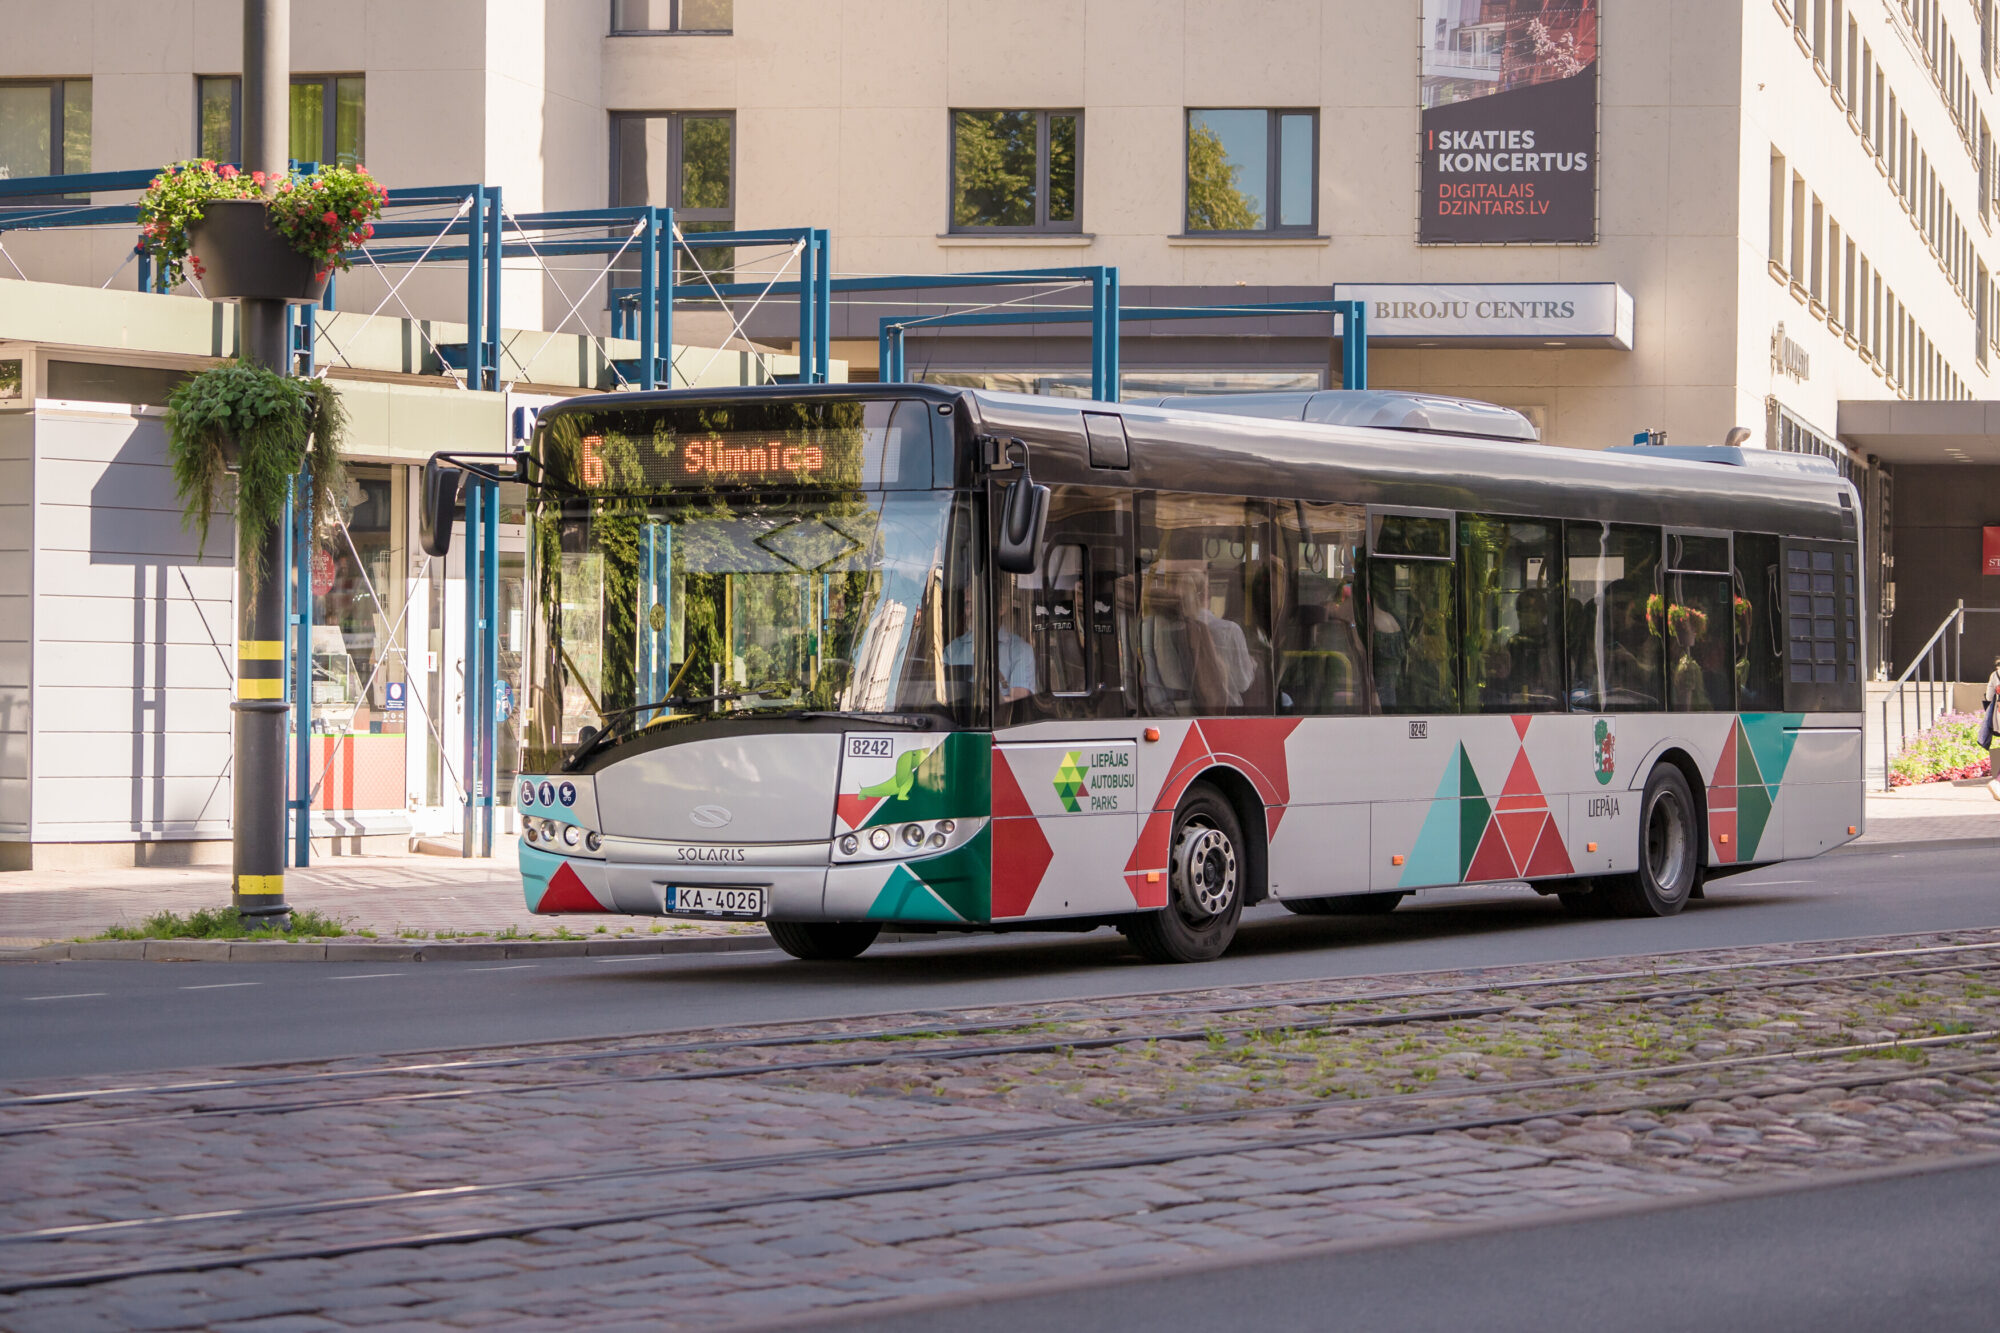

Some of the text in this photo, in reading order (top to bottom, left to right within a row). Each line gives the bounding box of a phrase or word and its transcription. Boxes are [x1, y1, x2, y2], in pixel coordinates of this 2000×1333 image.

[1438, 130, 1535, 150] SKATIES
[1438, 152, 1588, 172] KONCERTUS
[1439, 183, 1535, 198] DIGITALAIS
[1438, 200, 1550, 215] DZINTARS.LV
[1374, 301, 1575, 319] BIROJU CENTRS
[584, 435, 823, 484] 6 Slimnīca
[1411, 723, 1426, 736] 8242
[852, 739, 889, 755] 8242
[1091, 750, 1129, 768] LIEPĀJAS
[1091, 774, 1135, 789] AUTOBUSU
[1091, 795, 1118, 811] PARKS
[1588, 795, 1620, 820] LIEPĀJA
[677, 847, 745, 861] SOLARIS
[680, 889, 757, 910] KA-4026
